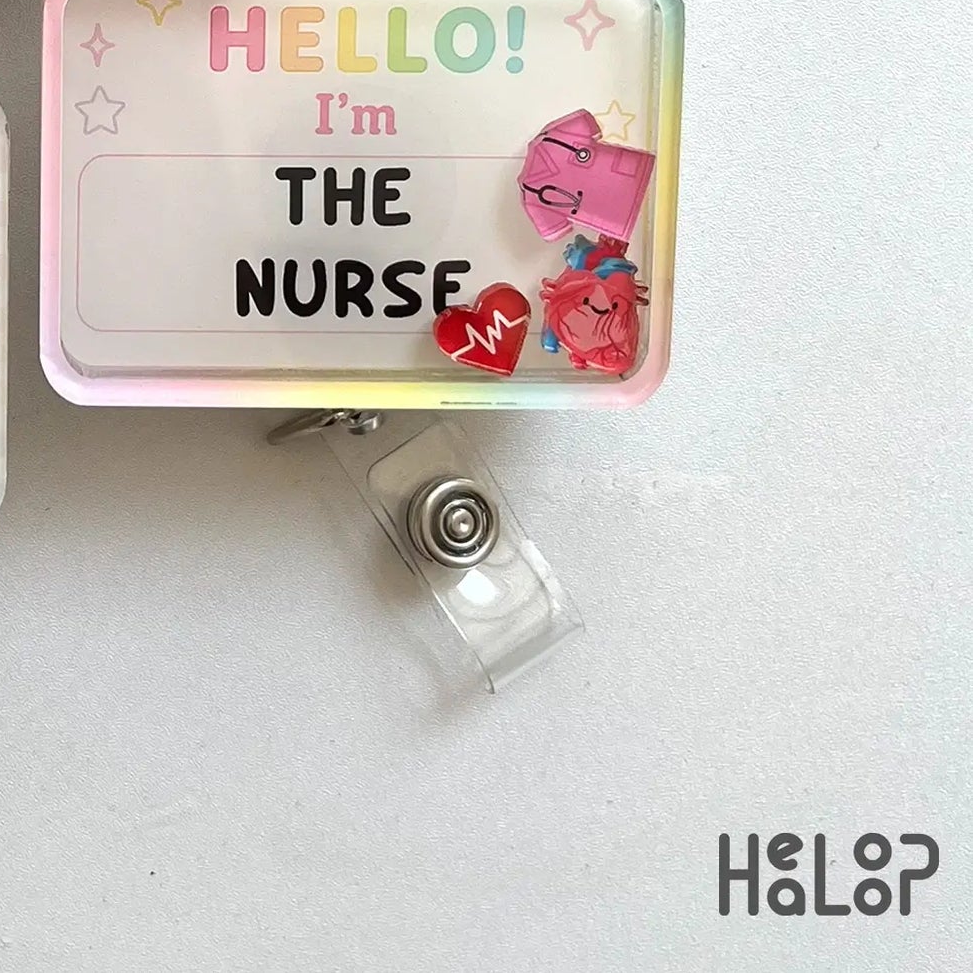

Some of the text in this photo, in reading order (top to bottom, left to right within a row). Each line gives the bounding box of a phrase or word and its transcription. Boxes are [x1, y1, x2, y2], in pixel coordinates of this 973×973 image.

[209, 5, 526, 73] HELLO!
[315, 92, 396, 136] I'm
[275, 167, 411, 227] THE
[235, 258, 471, 319] NURSE
